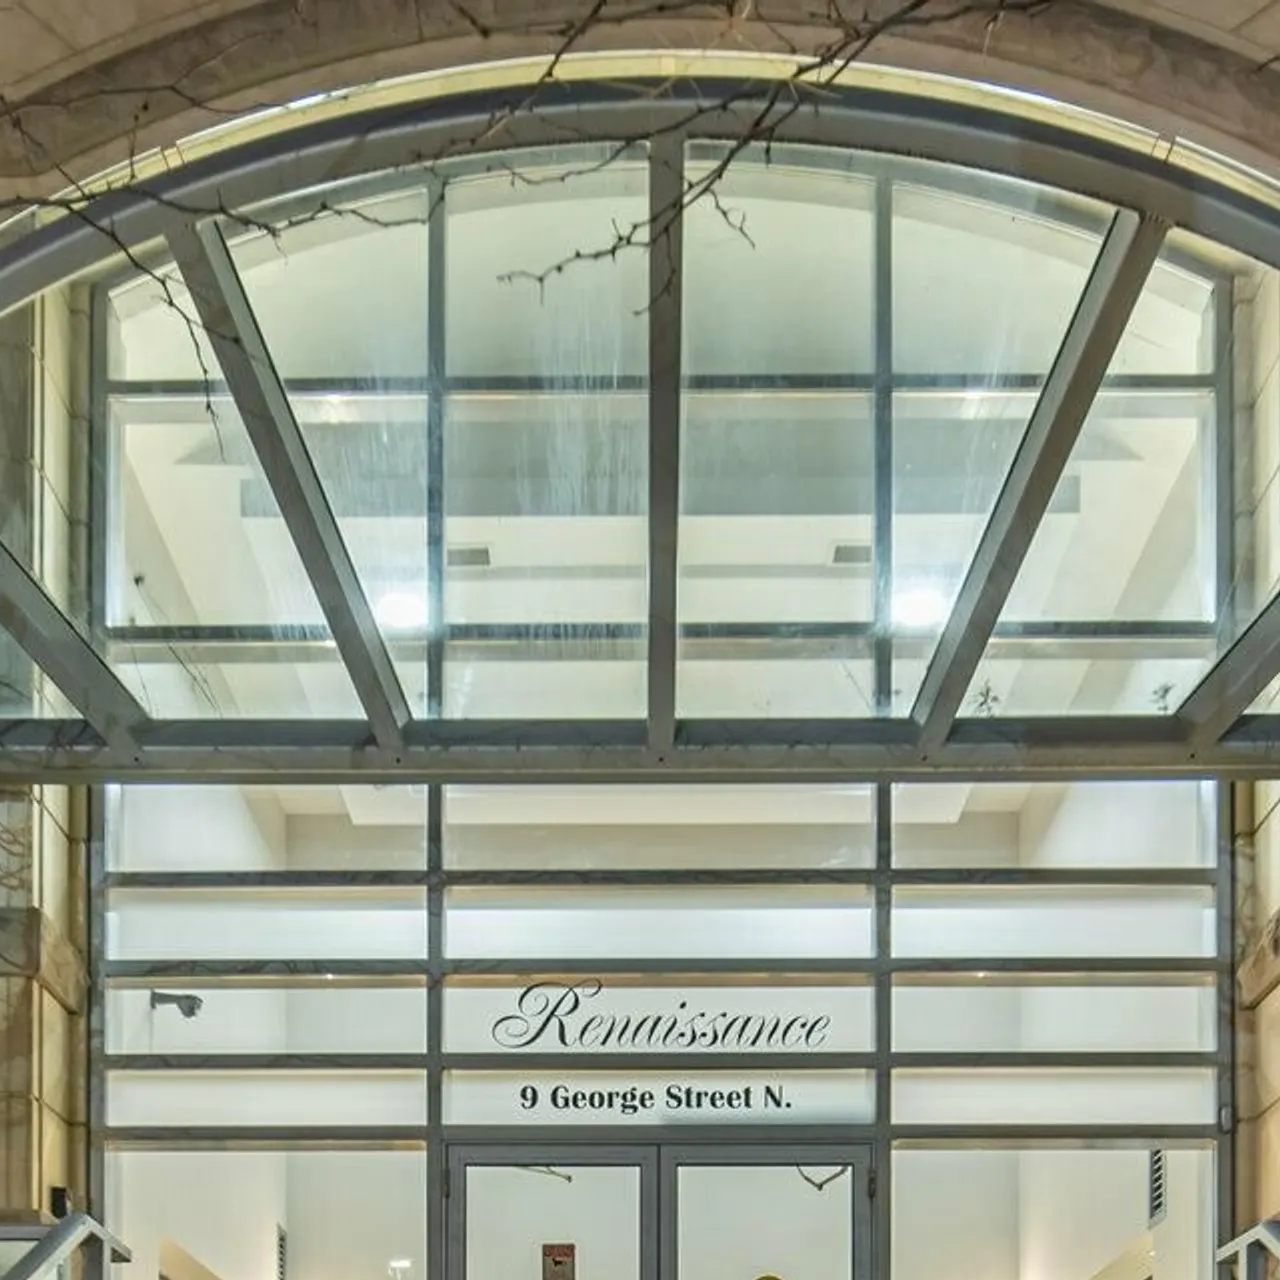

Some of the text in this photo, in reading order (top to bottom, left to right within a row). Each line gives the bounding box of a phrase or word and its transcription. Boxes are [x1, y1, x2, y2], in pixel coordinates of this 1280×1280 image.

[492, 977, 831, 1050] Renaissance
[520, 1084, 792, 1115] 9 George Street N.
